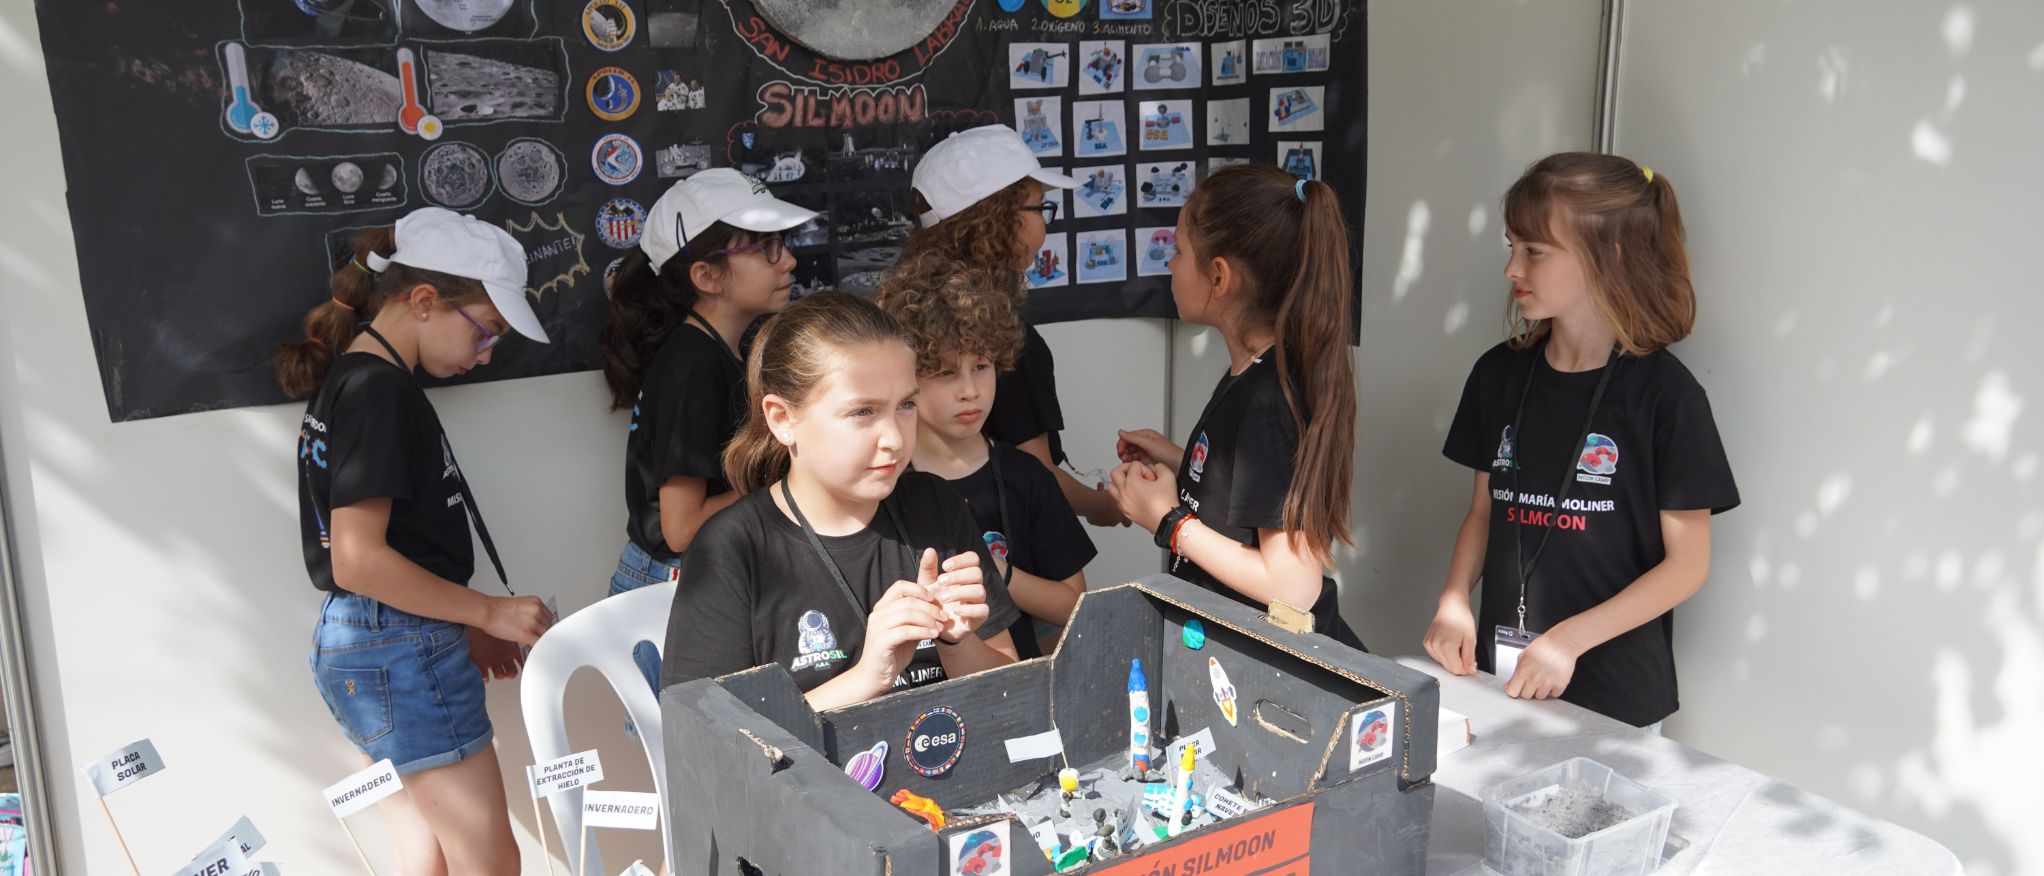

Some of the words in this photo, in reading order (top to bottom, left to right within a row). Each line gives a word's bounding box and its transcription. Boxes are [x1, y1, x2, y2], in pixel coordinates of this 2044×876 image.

[989, 19, 1019, 32] AGUA
[738, 16, 790, 61] SAN
[808, 59, 900, 84] ISIDRO
[758, 82, 927, 128] SILMOON
[527, 236, 577, 264] INANTE!
[1519, 493, 1555, 508] MARÍA
[1561, 498, 1615, 511] MOLINER
[1508, 507, 1586, 530] SLMOON
[790, 649, 847, 671] ASTROSIL
[1179, 739, 1200, 752] PLCA
[111, 751, 141, 770] PLACA
[544, 761, 573, 773] PLANTA
[575, 757, 585, 766] DE
[117, 762, 147, 781] SOLAR
[536, 766, 584, 786] EXTRACCIÓN
[586, 764, 596, 773] DE
[331, 772, 393, 808] INVERNADERO
[558, 778, 580, 789] HIELO
[584, 803, 654, 815] INVERNADERO
[1182, 829, 1276, 876] SILMOON
